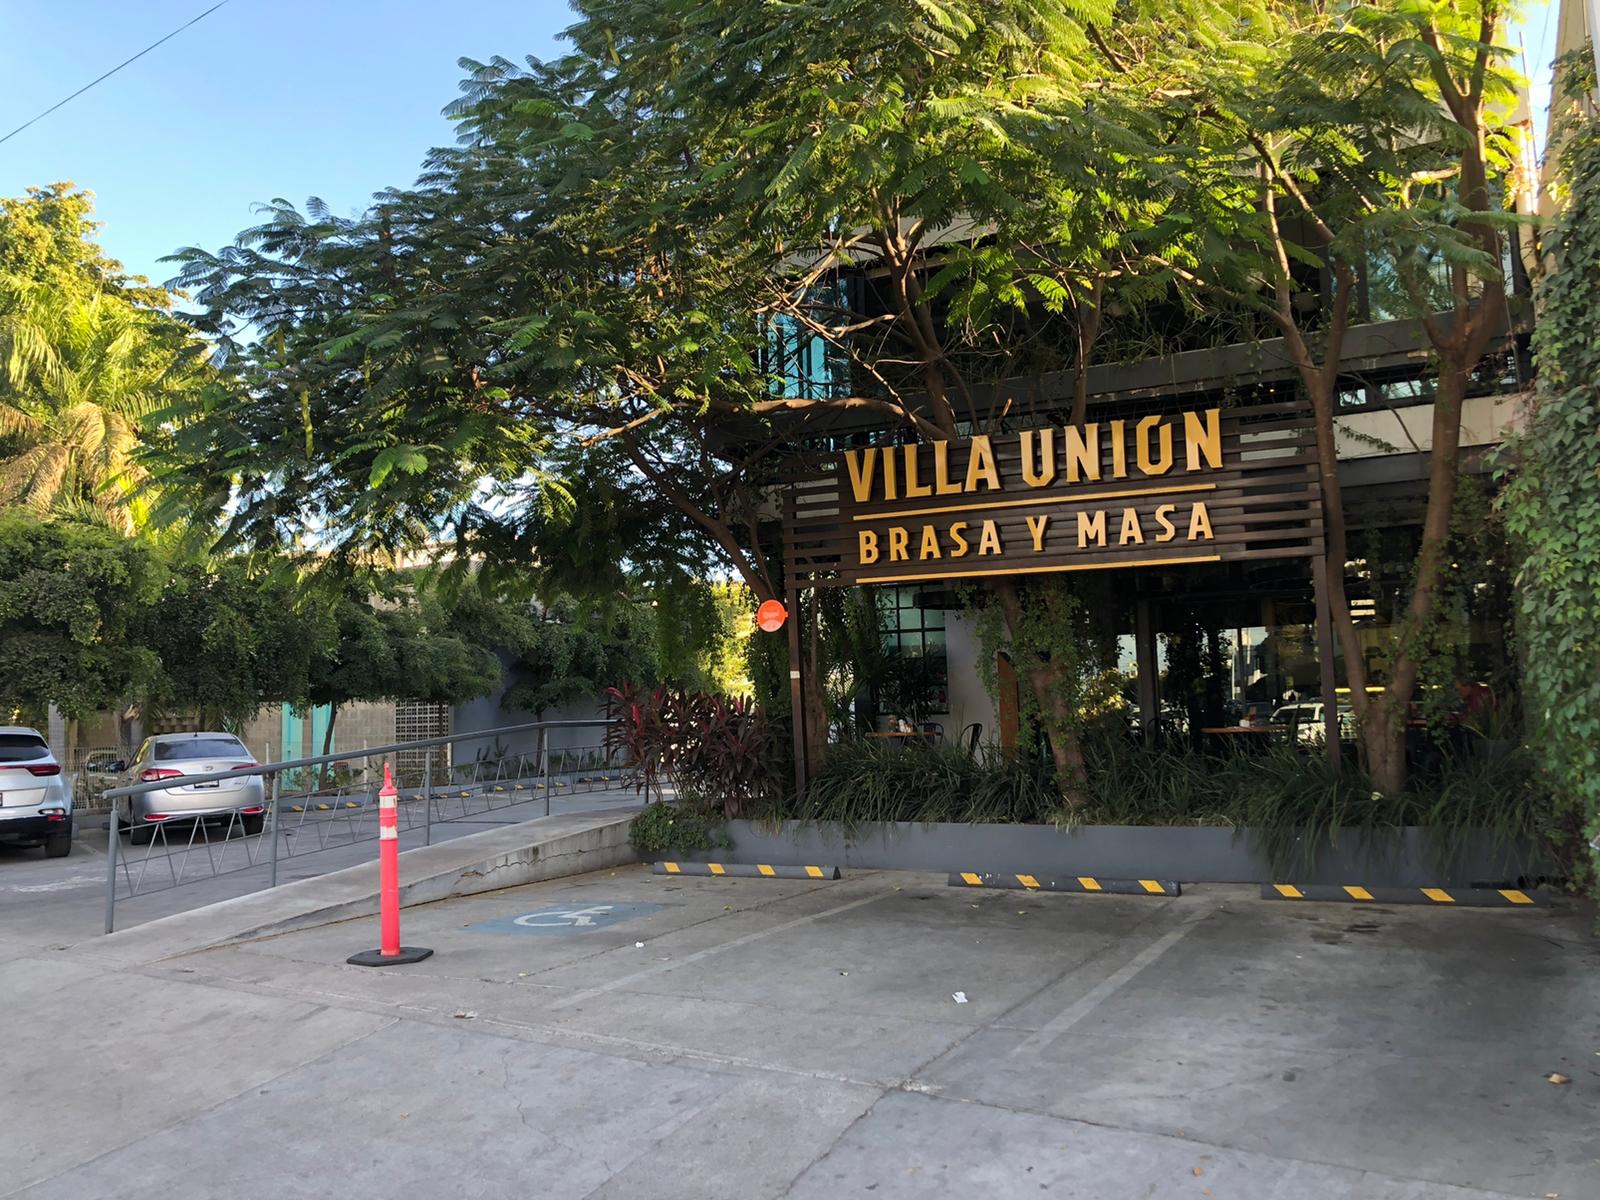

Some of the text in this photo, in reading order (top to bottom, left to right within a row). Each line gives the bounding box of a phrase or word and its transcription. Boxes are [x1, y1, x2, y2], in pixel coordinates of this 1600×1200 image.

[844, 435, 1001, 502] VILLA
[858, 502, 1215, 565] BRASA Y MASA
